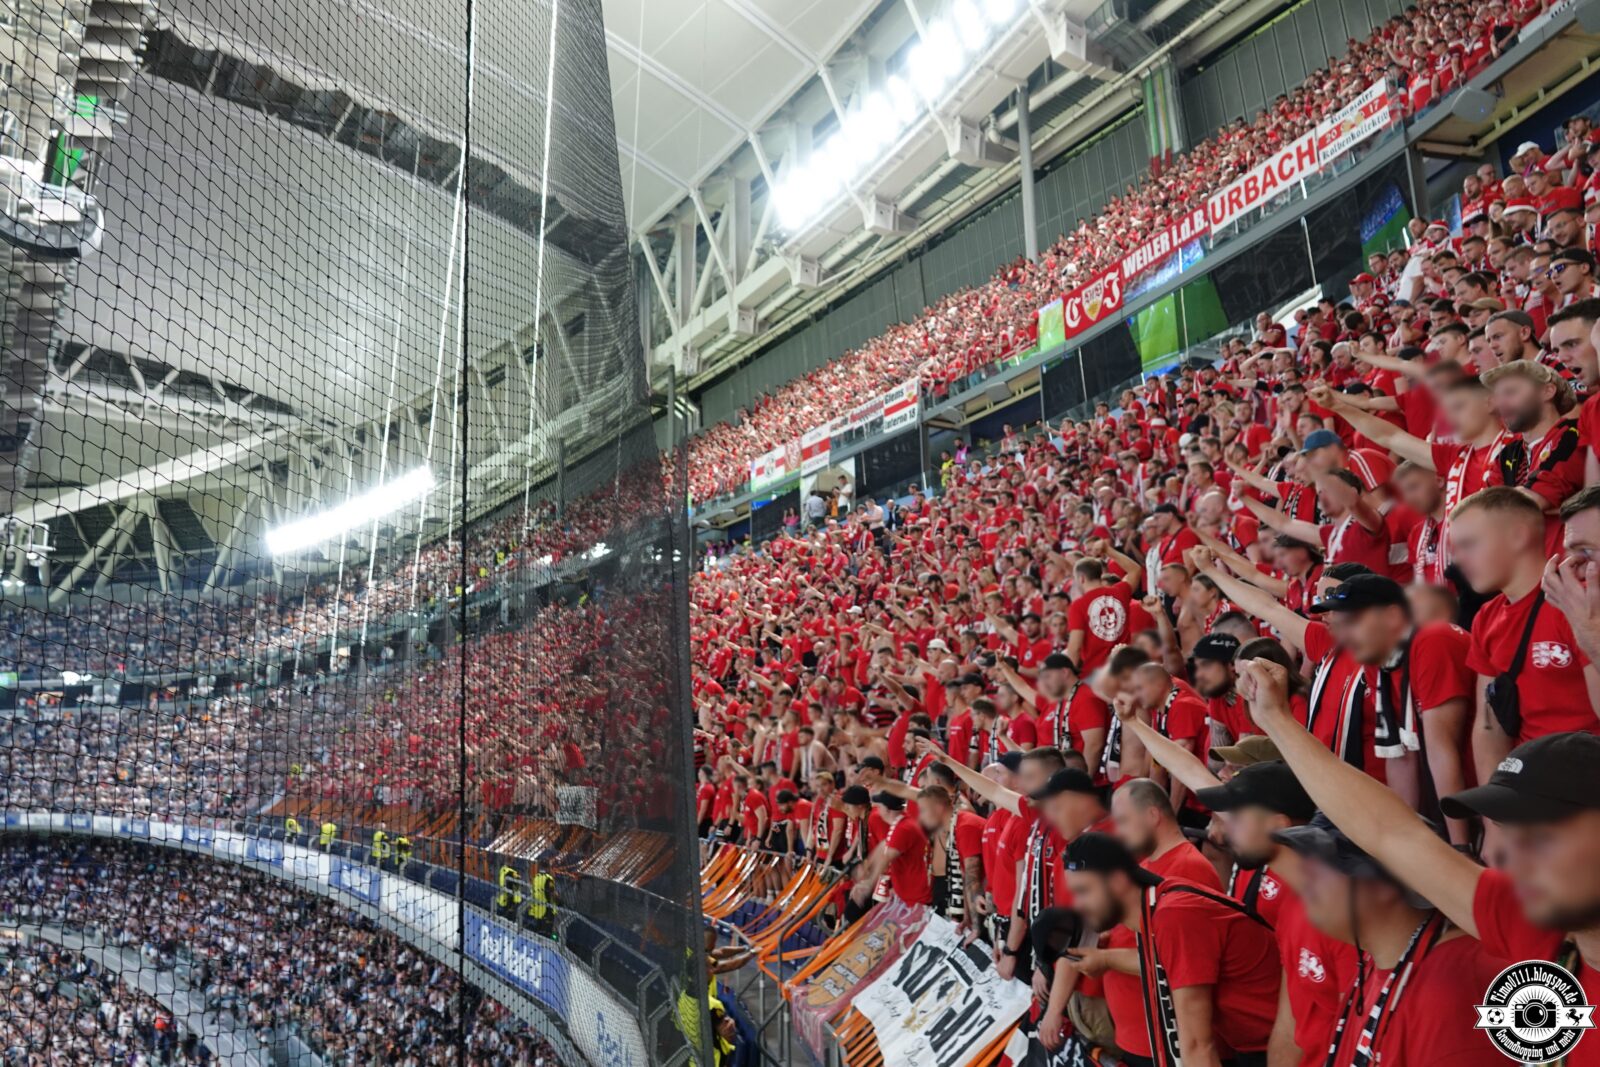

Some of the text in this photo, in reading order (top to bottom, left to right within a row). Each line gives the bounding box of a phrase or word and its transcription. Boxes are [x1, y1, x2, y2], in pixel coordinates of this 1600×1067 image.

[1368, 98, 1380, 114] 17
[1325, 128, 1338, 142] 20
[1210, 136, 1317, 226] URBACH
[1122, 231, 1171, 279] WEILER
